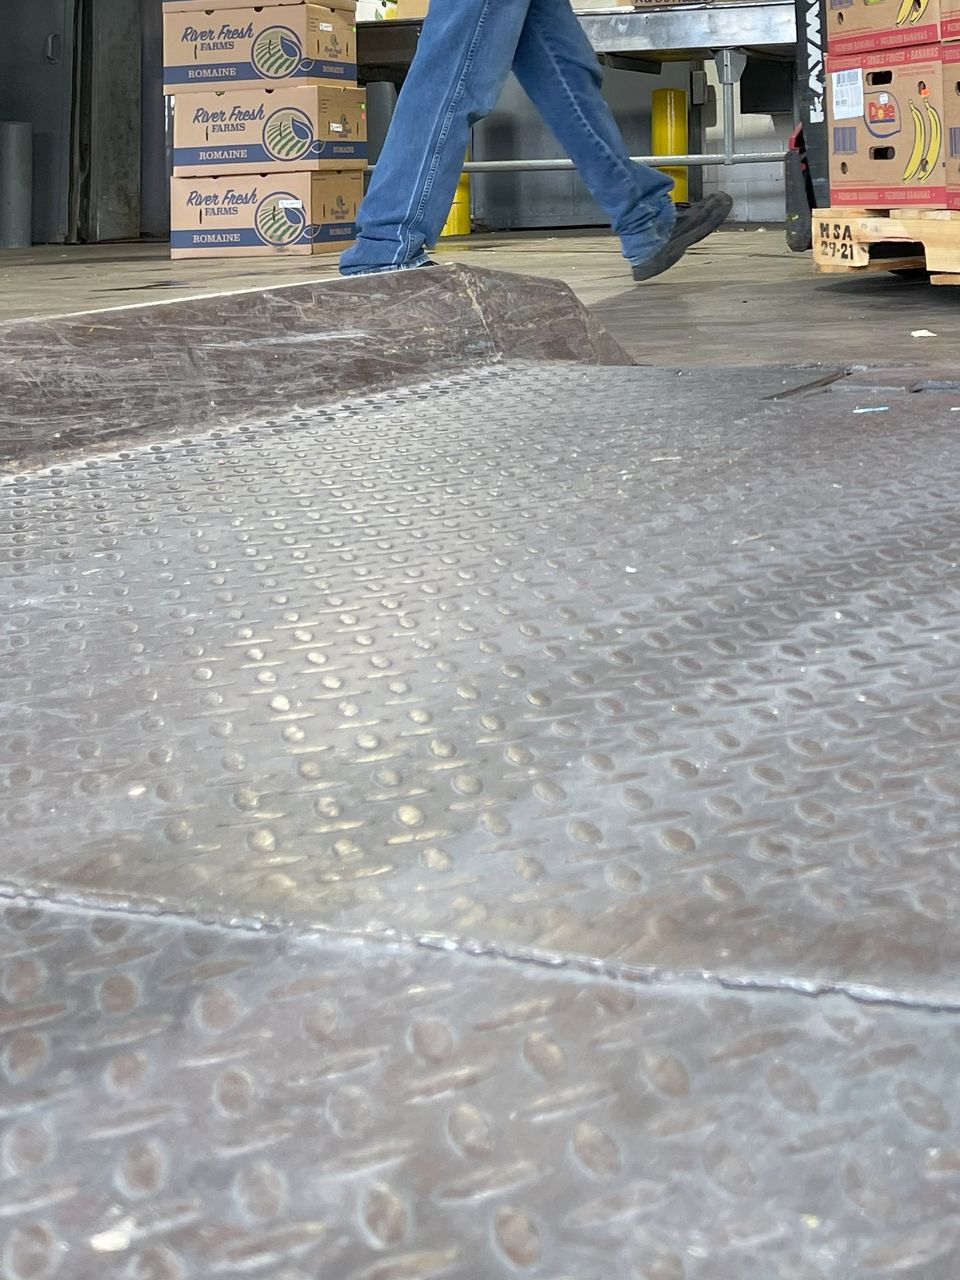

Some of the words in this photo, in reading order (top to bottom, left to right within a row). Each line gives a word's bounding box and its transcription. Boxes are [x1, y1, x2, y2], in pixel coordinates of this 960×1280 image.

[181, 26, 215, 42] River
[217, 22, 255, 40] Fresh
[201, 41, 235, 51] FARMS
[188, 67, 236, 78] ROMAINE
[193, 108, 227, 124] River
[229, 104, 266, 121] Fresh
[212, 123, 246, 133] FARMS
[199, 150, 247, 160] ROMAINE
[187, 191, 220, 207] River
[223, 187, 259, 205] Fresh
[205, 207, 238, 217] FARMS
[193, 233, 241, 244] ROMAINE
